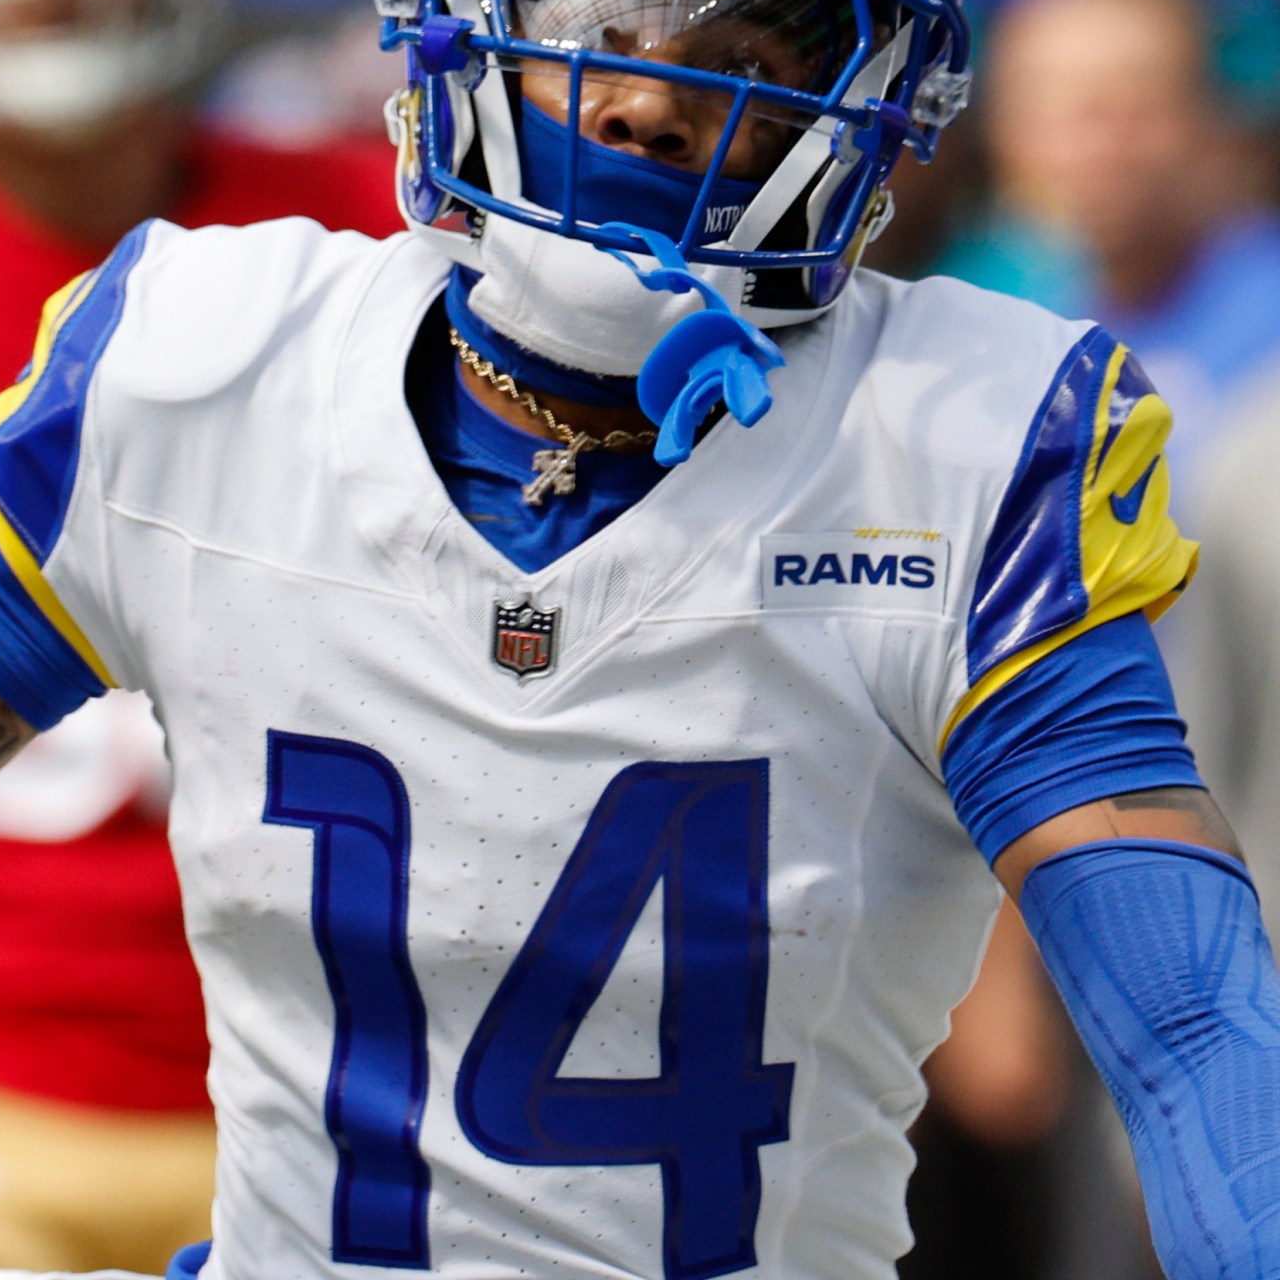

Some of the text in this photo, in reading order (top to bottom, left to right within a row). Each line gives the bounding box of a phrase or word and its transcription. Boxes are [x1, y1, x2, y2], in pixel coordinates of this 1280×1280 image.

[773, 552, 936, 589] RAMS
[496, 629, 549, 667] NFL
[263, 728, 797, 1280] 14
